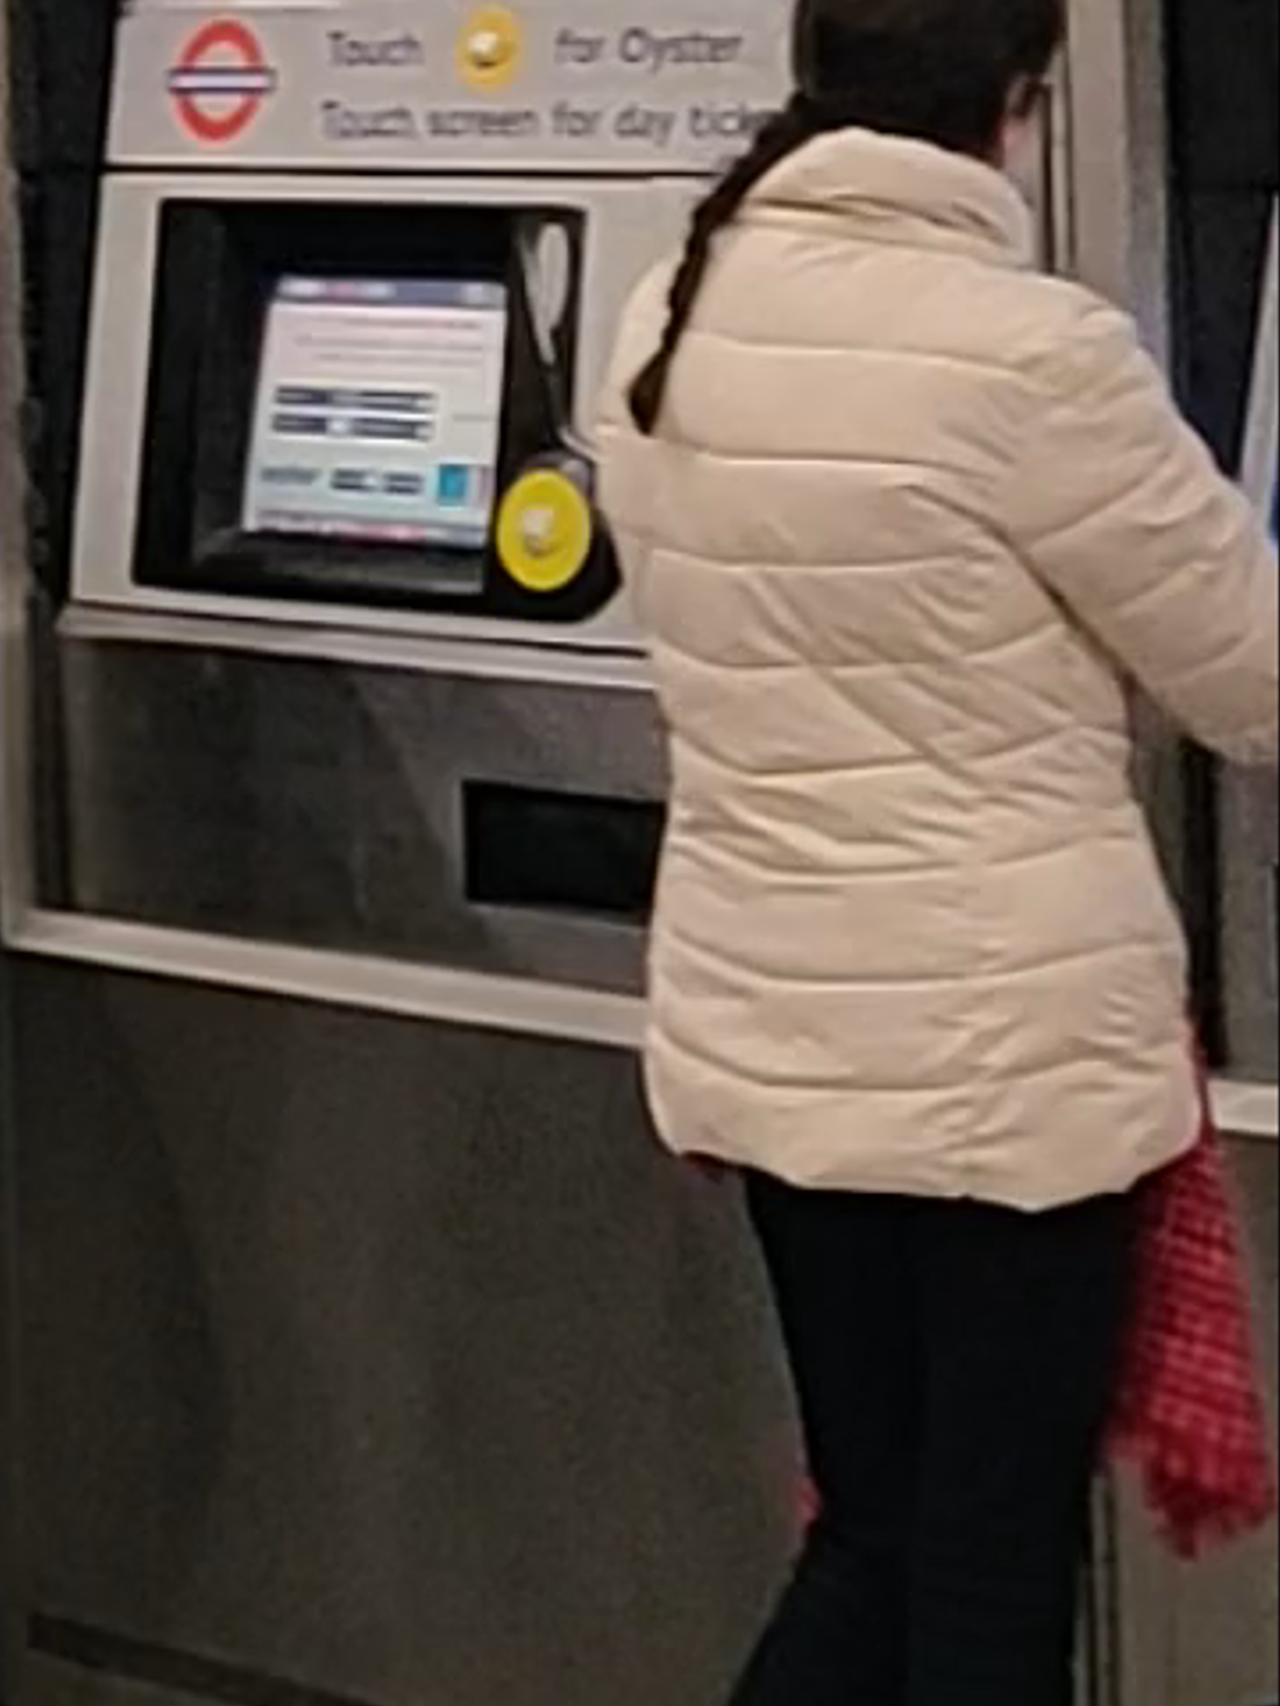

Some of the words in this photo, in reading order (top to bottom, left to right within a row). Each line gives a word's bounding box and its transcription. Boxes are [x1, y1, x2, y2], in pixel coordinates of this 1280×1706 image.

[327, 29, 423, 66] Touch
[554, 30, 603, 64] for
[620, 28, 743, 74] Oyster
[552, 101, 602, 137] for
